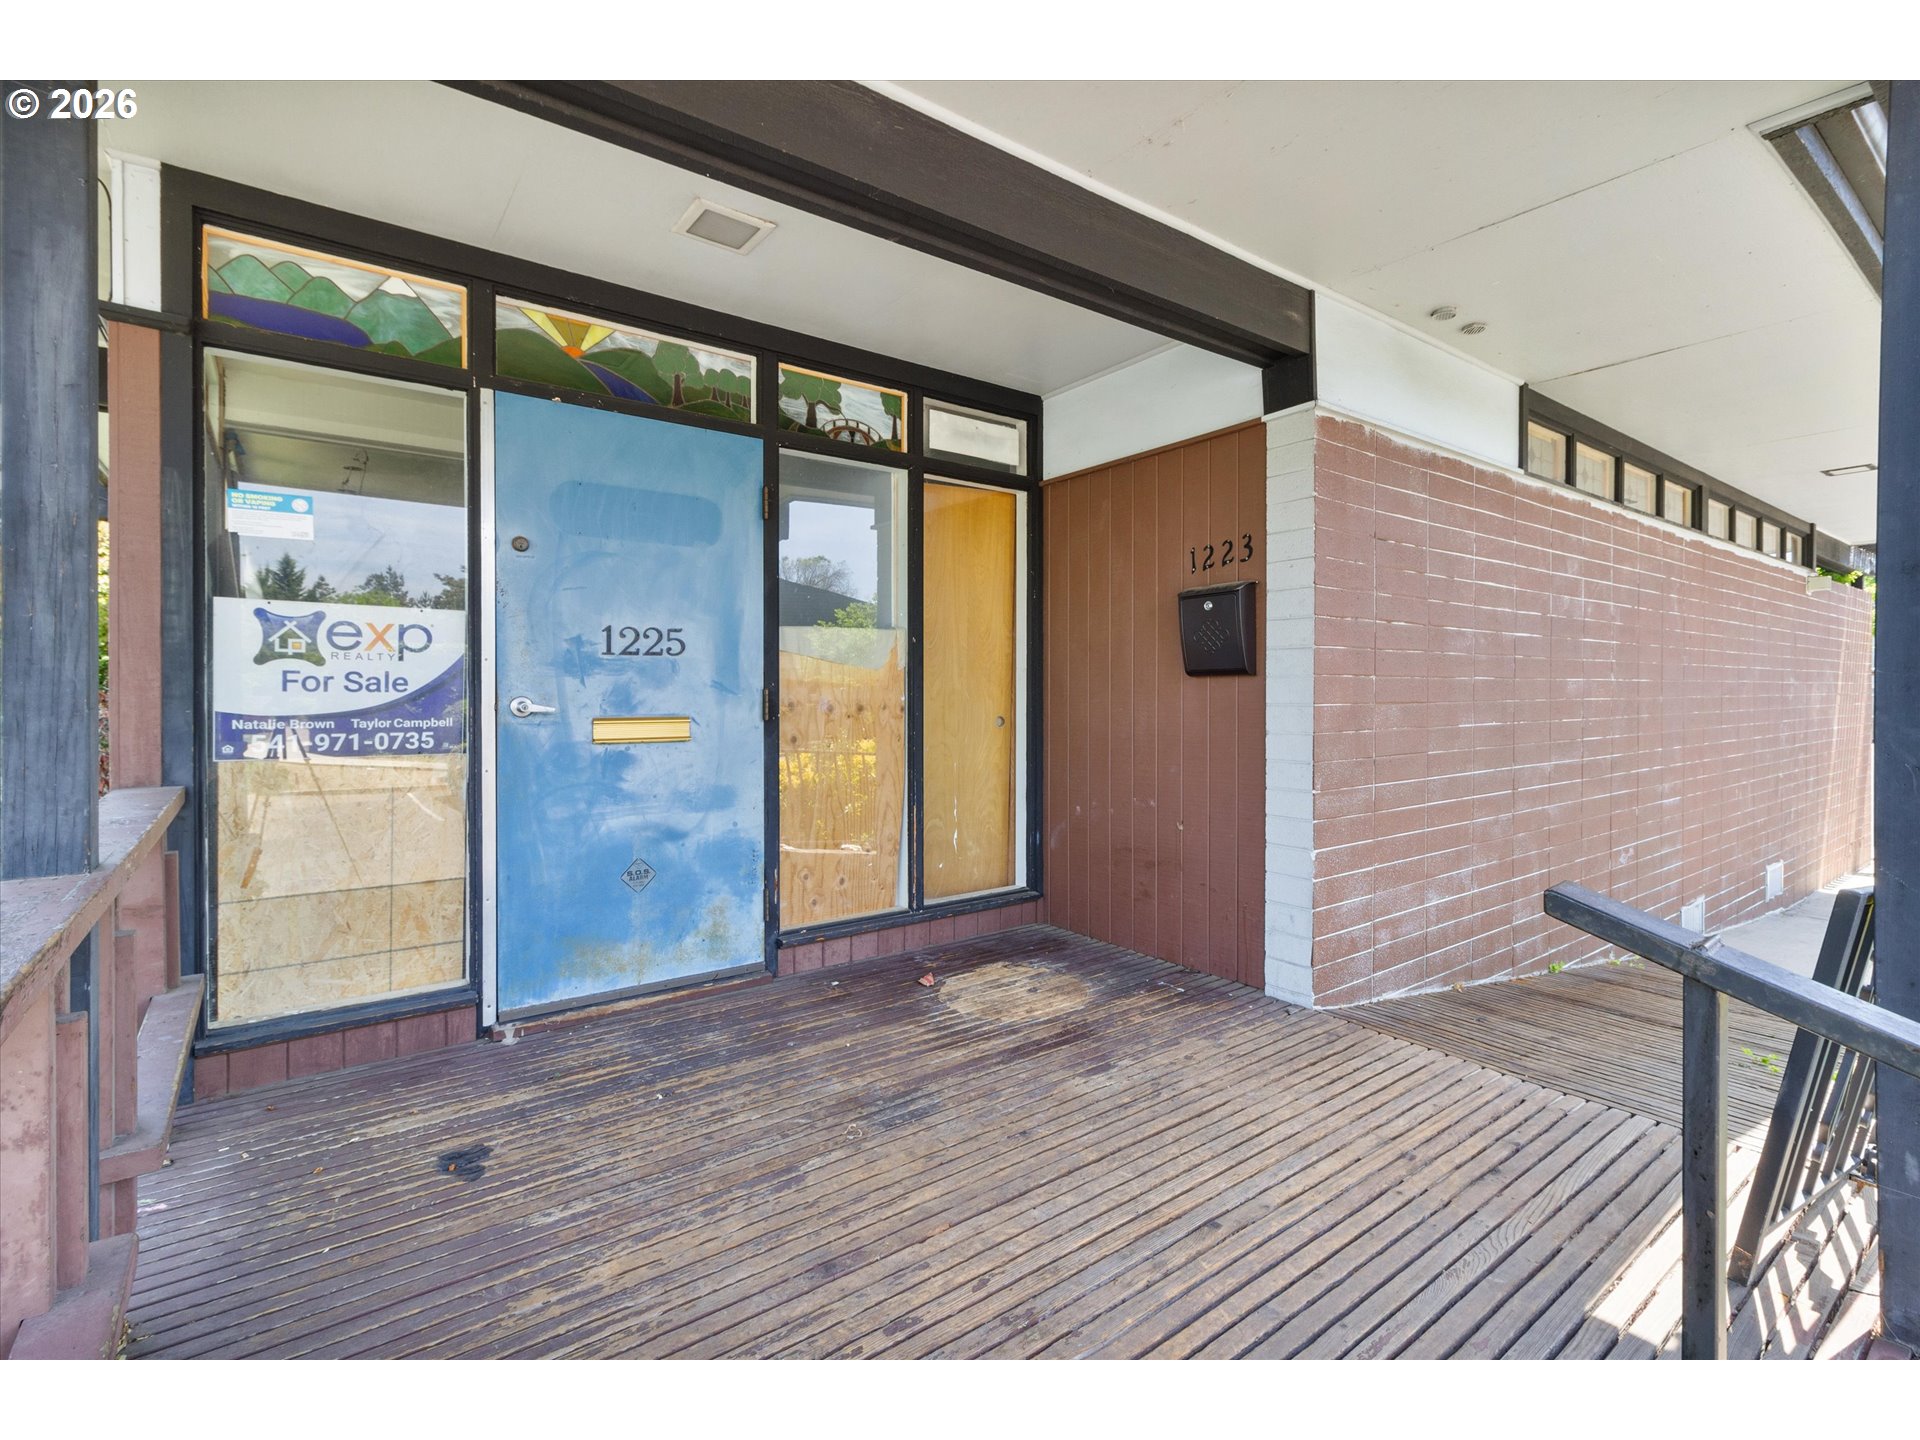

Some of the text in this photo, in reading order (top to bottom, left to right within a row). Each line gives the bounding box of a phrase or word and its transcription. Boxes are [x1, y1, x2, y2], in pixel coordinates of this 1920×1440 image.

[1190, 533, 1254, 575] 1223
[326, 620, 433, 662] exp
[601, 625, 686, 656] 1225
[330, 651, 396, 661] REALTY
[282, 670, 409, 693] For Sale
[231, 719, 335, 730] Natalie Brown
[350, 717, 453, 730] Taylor Campbell
